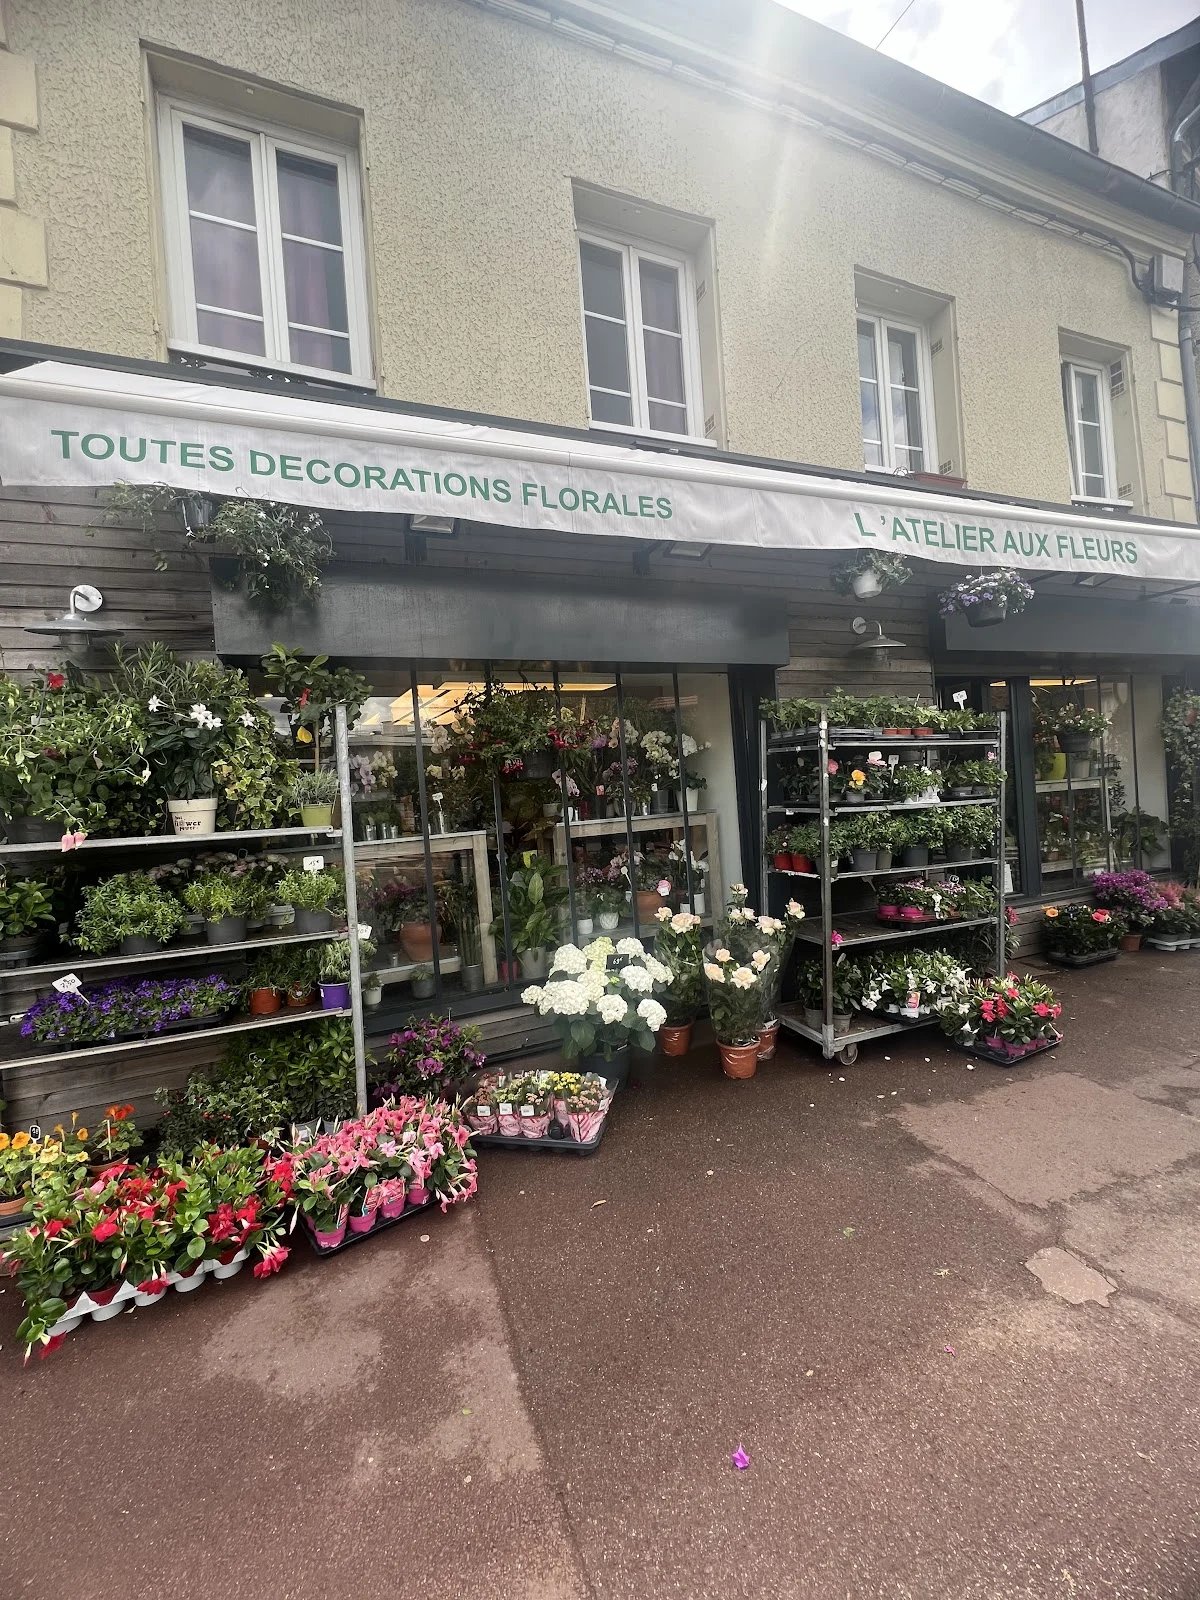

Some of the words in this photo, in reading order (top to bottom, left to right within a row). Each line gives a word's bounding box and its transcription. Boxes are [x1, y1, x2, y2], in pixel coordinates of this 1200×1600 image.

[51, 430, 235, 472] TOUTES
[250, 449, 512, 503] DECORATIONS
[522, 482, 673, 520] FLORALES
[1003, 530, 1051, 558] AUX
[1056, 534, 1138, 565] FLEURS
